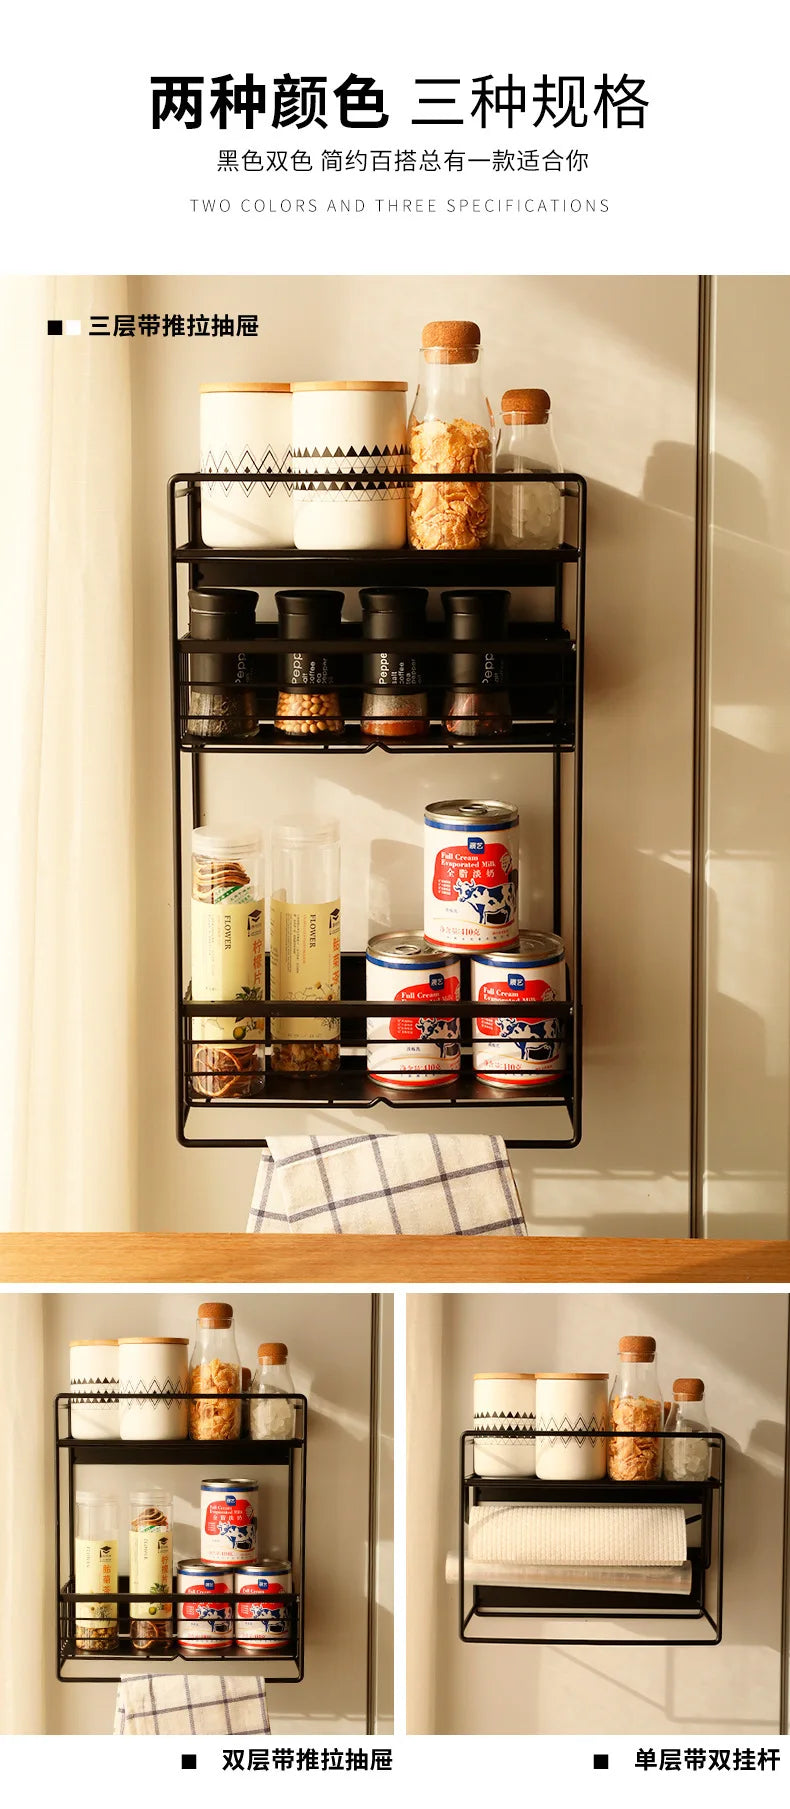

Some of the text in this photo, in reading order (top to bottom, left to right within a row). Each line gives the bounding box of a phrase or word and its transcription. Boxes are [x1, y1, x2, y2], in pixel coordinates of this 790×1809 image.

[441, 852, 453, 860] Full
[441, 859, 480, 868] Evaporated
[447, 868, 495, 878] 全脂淡奶
[309, 914, 317, 949] FLOWER
[401, 991, 440, 1000] Full Cream
[483, 986, 519, 997] Full Cream
